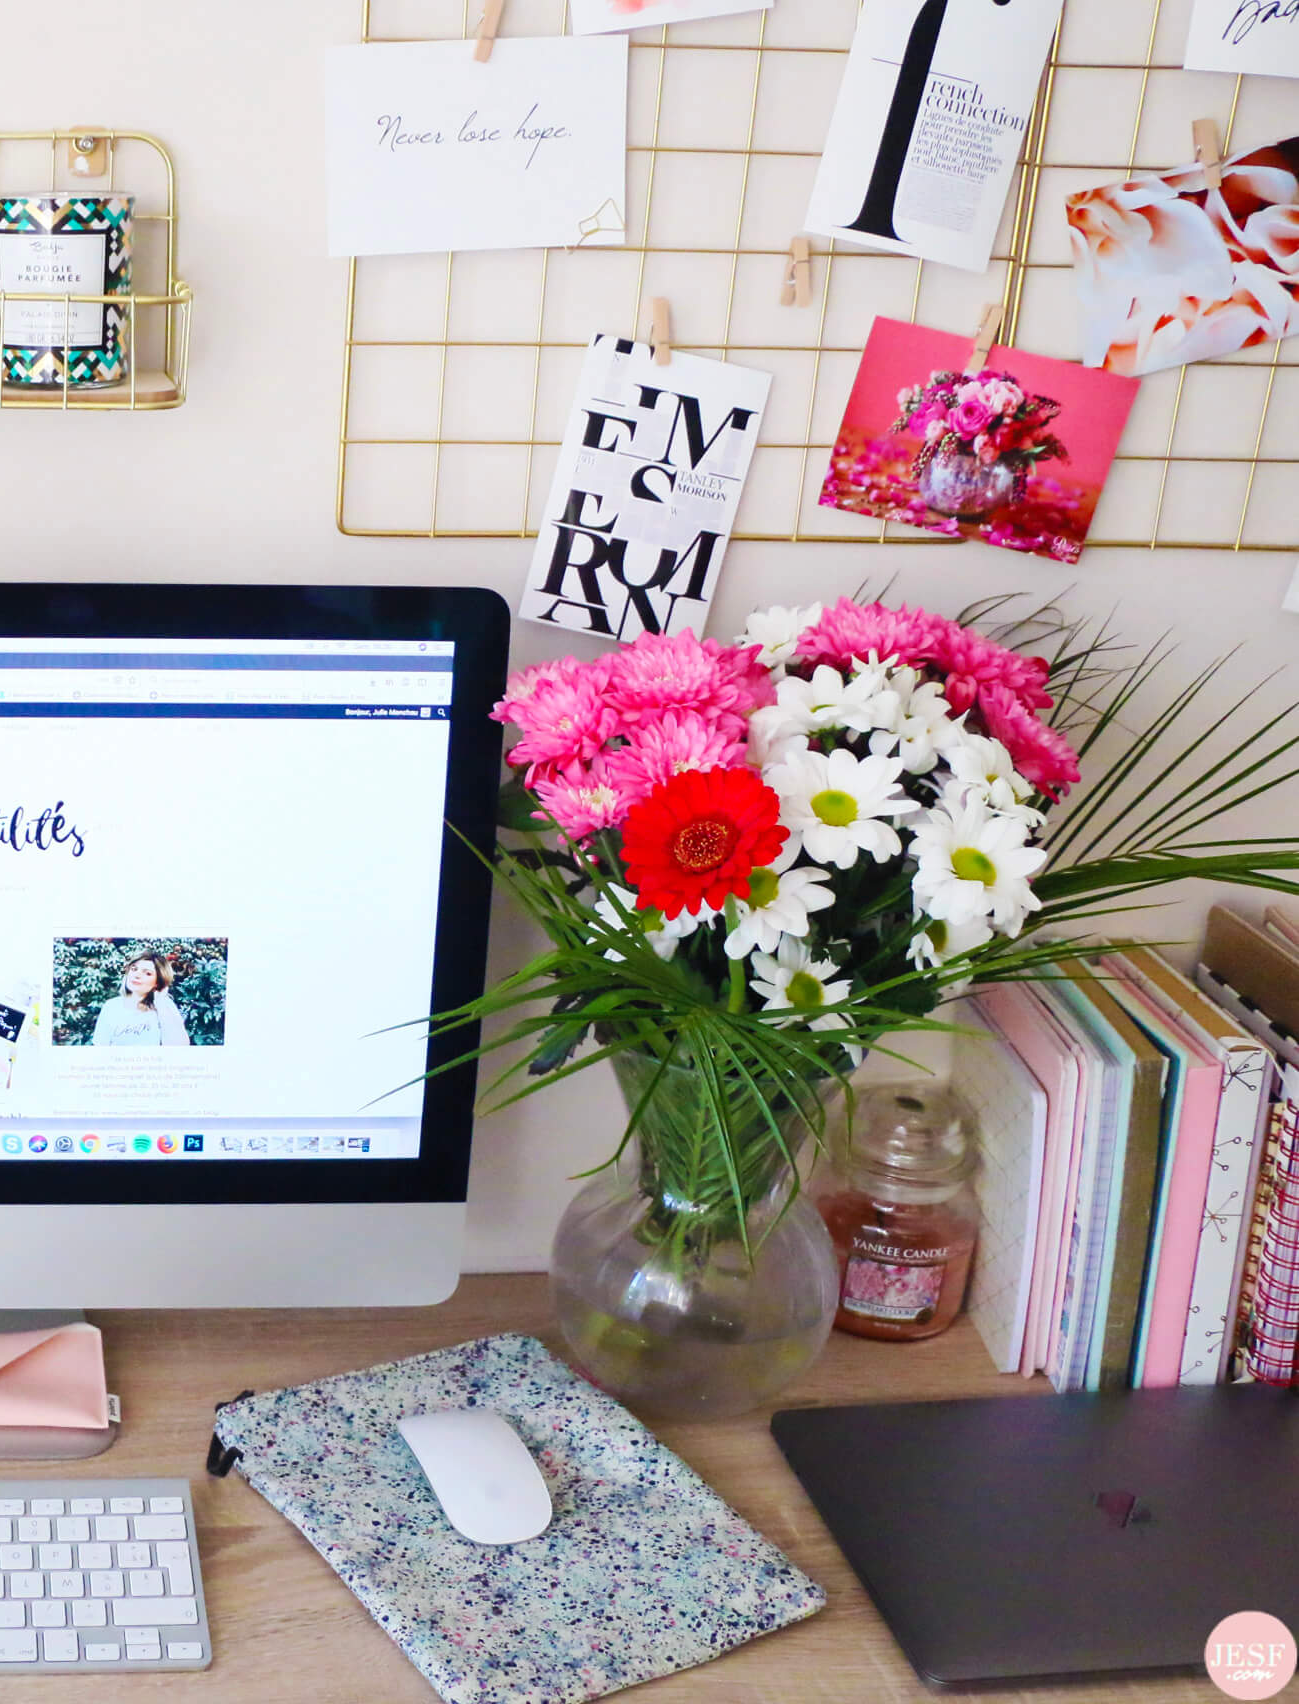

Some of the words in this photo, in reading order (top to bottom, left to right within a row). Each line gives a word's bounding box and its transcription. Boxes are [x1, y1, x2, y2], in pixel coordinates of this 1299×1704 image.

[926, 94, 1026, 132] connection
[377, 115, 444, 152] Never
[457, 110, 501, 143] lose
[514, 103, 573, 170] hope.
[18, 274, 82, 282] PARFUMÉE
[26, 265, 72, 273] BOUGIE
[676, 484, 727, 502] MORISON
[853, 1236, 901, 1257] YANKEE
[903, 1246, 950, 1259] CANDLE
